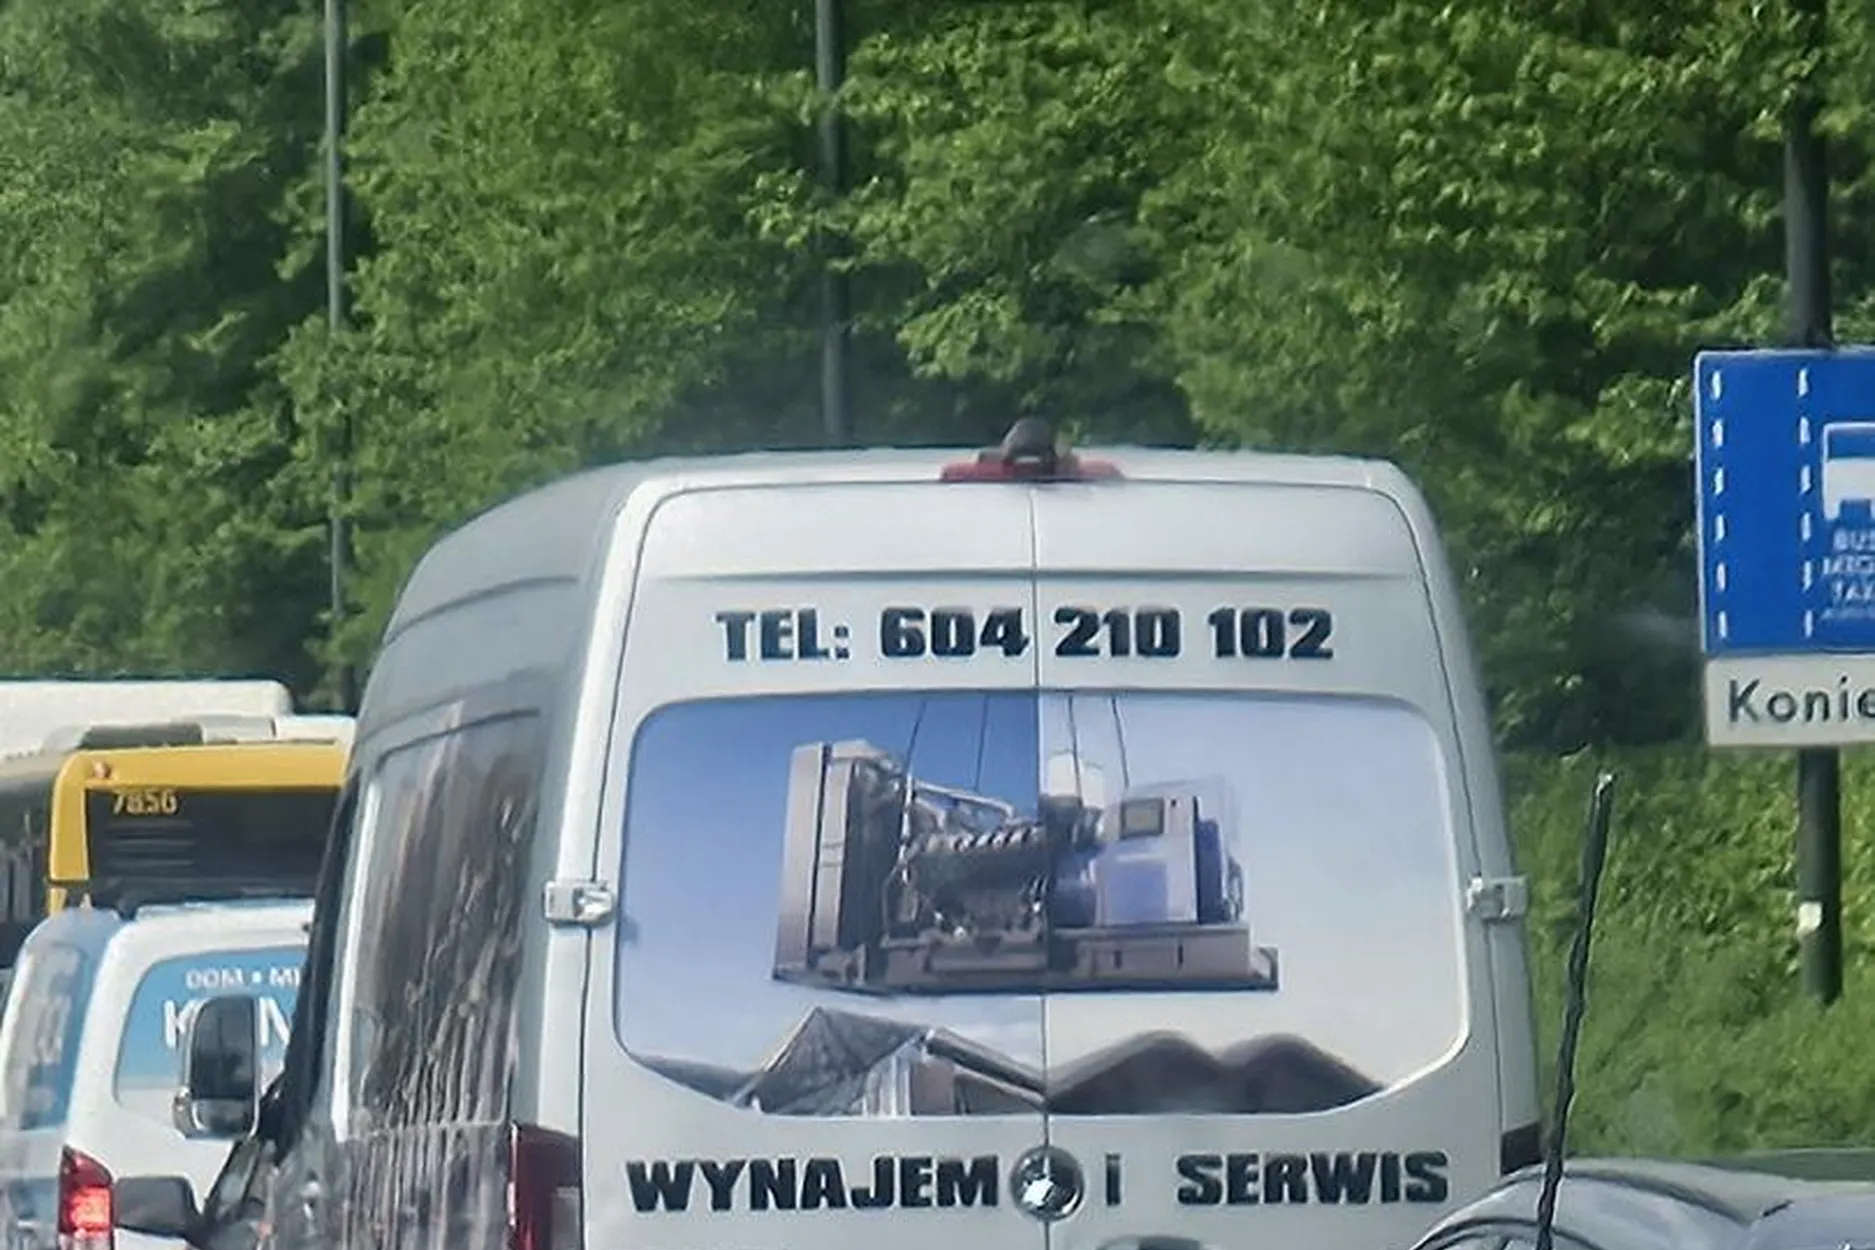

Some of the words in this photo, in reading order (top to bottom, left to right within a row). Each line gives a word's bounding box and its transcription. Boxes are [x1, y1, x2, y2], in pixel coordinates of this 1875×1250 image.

[715, 608, 850, 661] TEL:
[880, 607, 1030, 658] 604
[1054, 607, 1180, 658] 210
[1208, 608, 1334, 659] 102
[626, 1155, 1000, 1212] WYNAJEM
[1176, 1151, 1449, 1205] SERWIS
